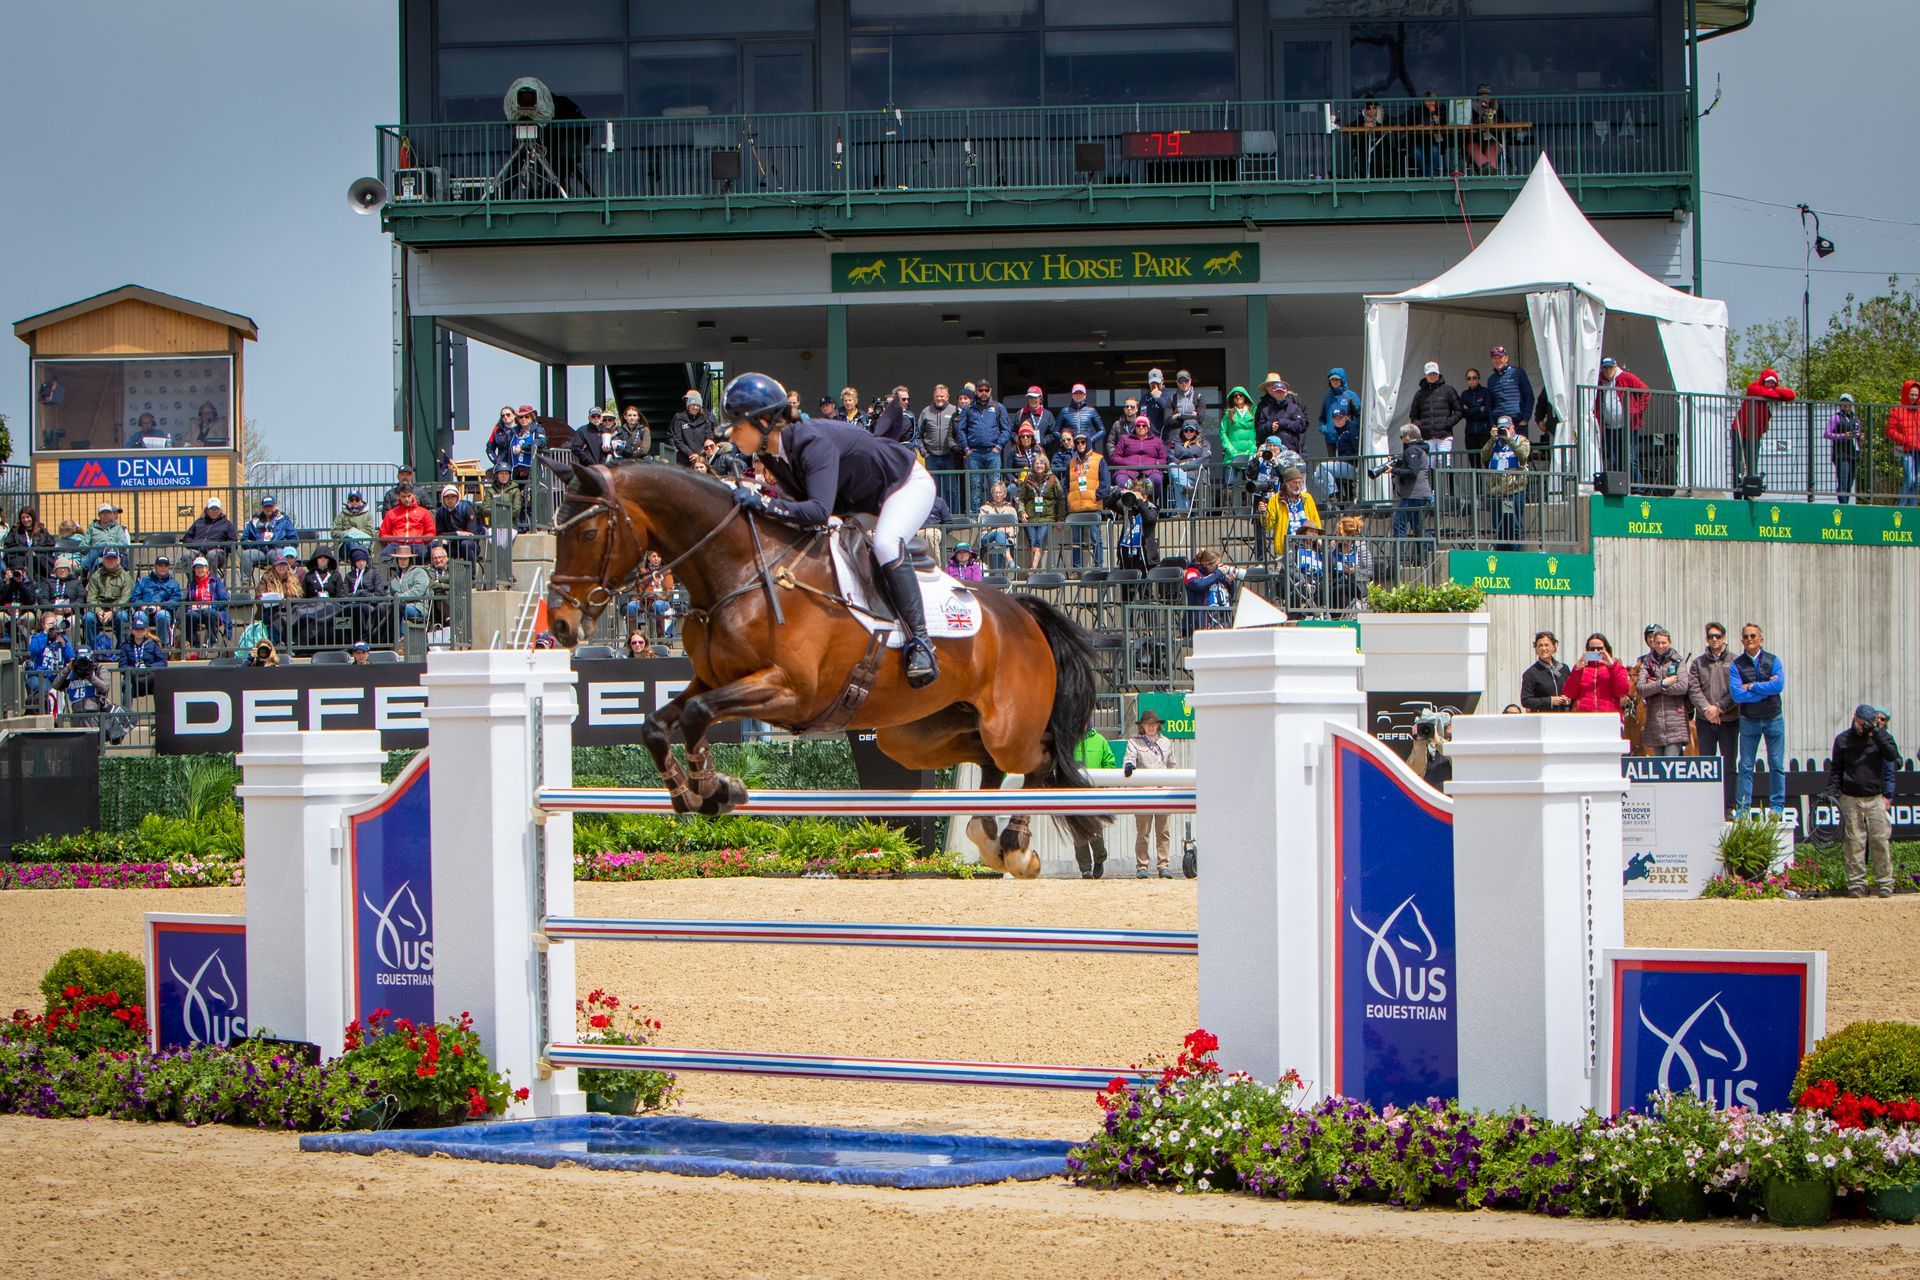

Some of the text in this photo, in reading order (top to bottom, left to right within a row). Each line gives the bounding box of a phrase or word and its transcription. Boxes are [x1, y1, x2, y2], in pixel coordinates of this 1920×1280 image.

[117, 458, 194, 477] DENALI
[121, 477, 191, 487] METAL BUILDINGS
[1628, 521, 1663, 534] ROLEX
[1695, 524, 1728, 537] ROLEX
[1759, 526, 1792, 538] ROLEX
[1821, 528, 1854, 540] ROLEX
[1882, 530, 1914, 543] ROLEX
[1474, 576, 1511, 589] ROLEX
[1535, 578, 1571, 591] ROLEX
[74, 688, 86, 699] 45
[1625, 760, 1719, 780] ALL YEAR!
[1648, 866, 1688, 874] GRAND
[1648, 874, 1689, 884] PRIX
[404, 941, 434, 971] US
[376, 973, 434, 986] EQUESTRIAN
[1404, 967, 1447, 1002] US
[1366, 1004, 1447, 1021] EQUESTRIAN
